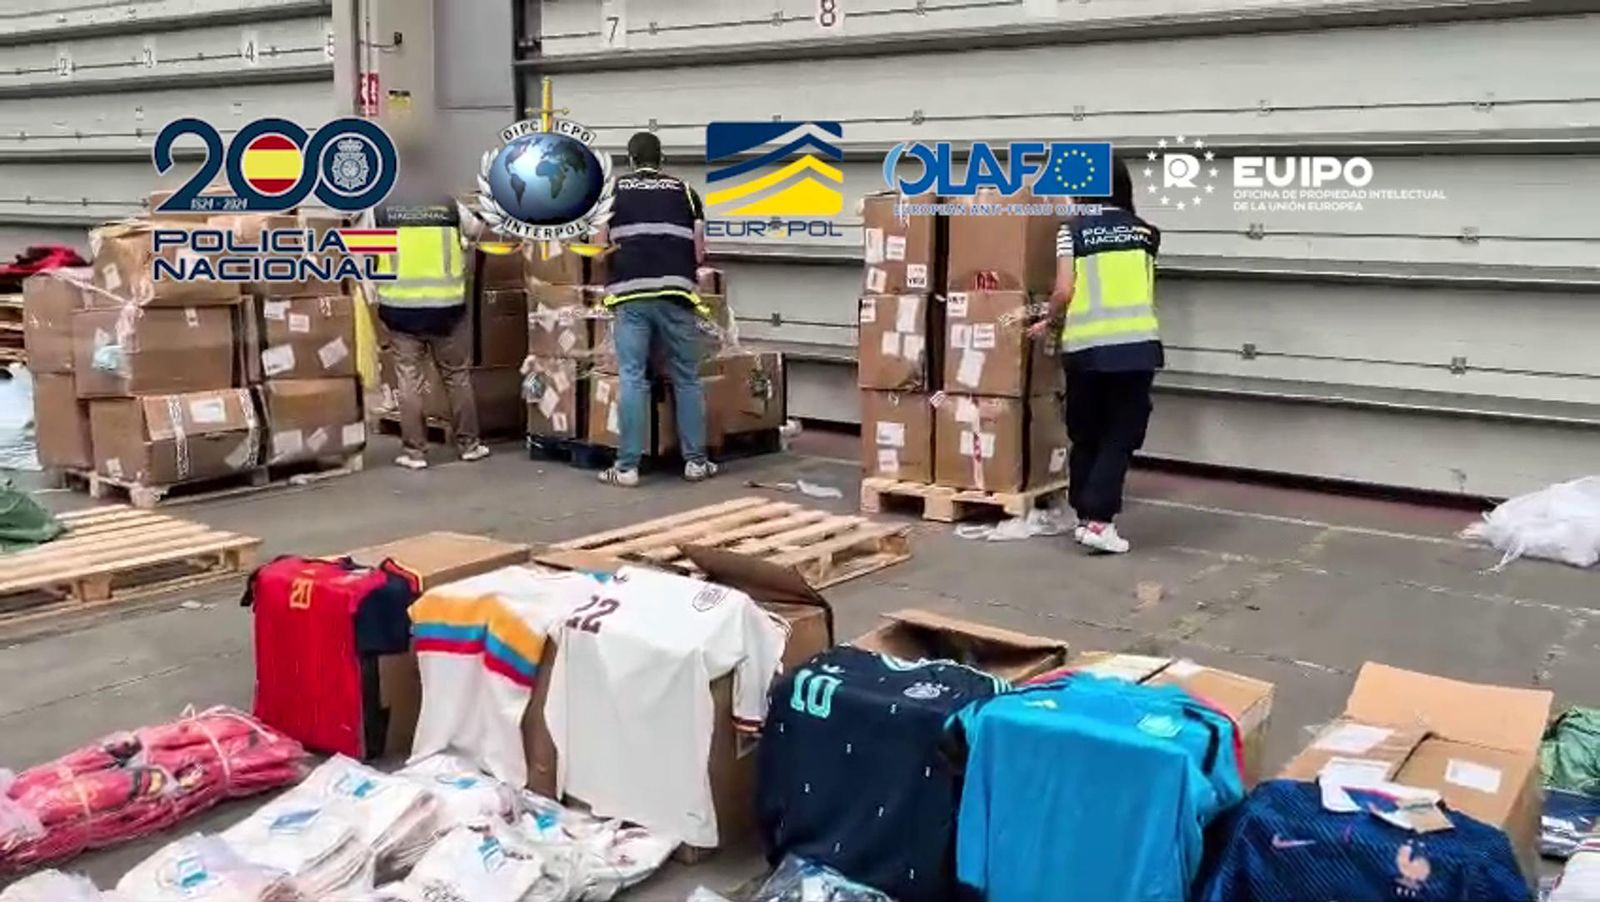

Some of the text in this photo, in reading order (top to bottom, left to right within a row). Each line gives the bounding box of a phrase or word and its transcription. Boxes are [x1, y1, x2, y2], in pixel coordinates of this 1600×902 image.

[606, 17, 619, 43] 7
[245, 41, 255, 62] 4
[565, 595, 620, 634] 22
[790, 669, 843, 719] 10
